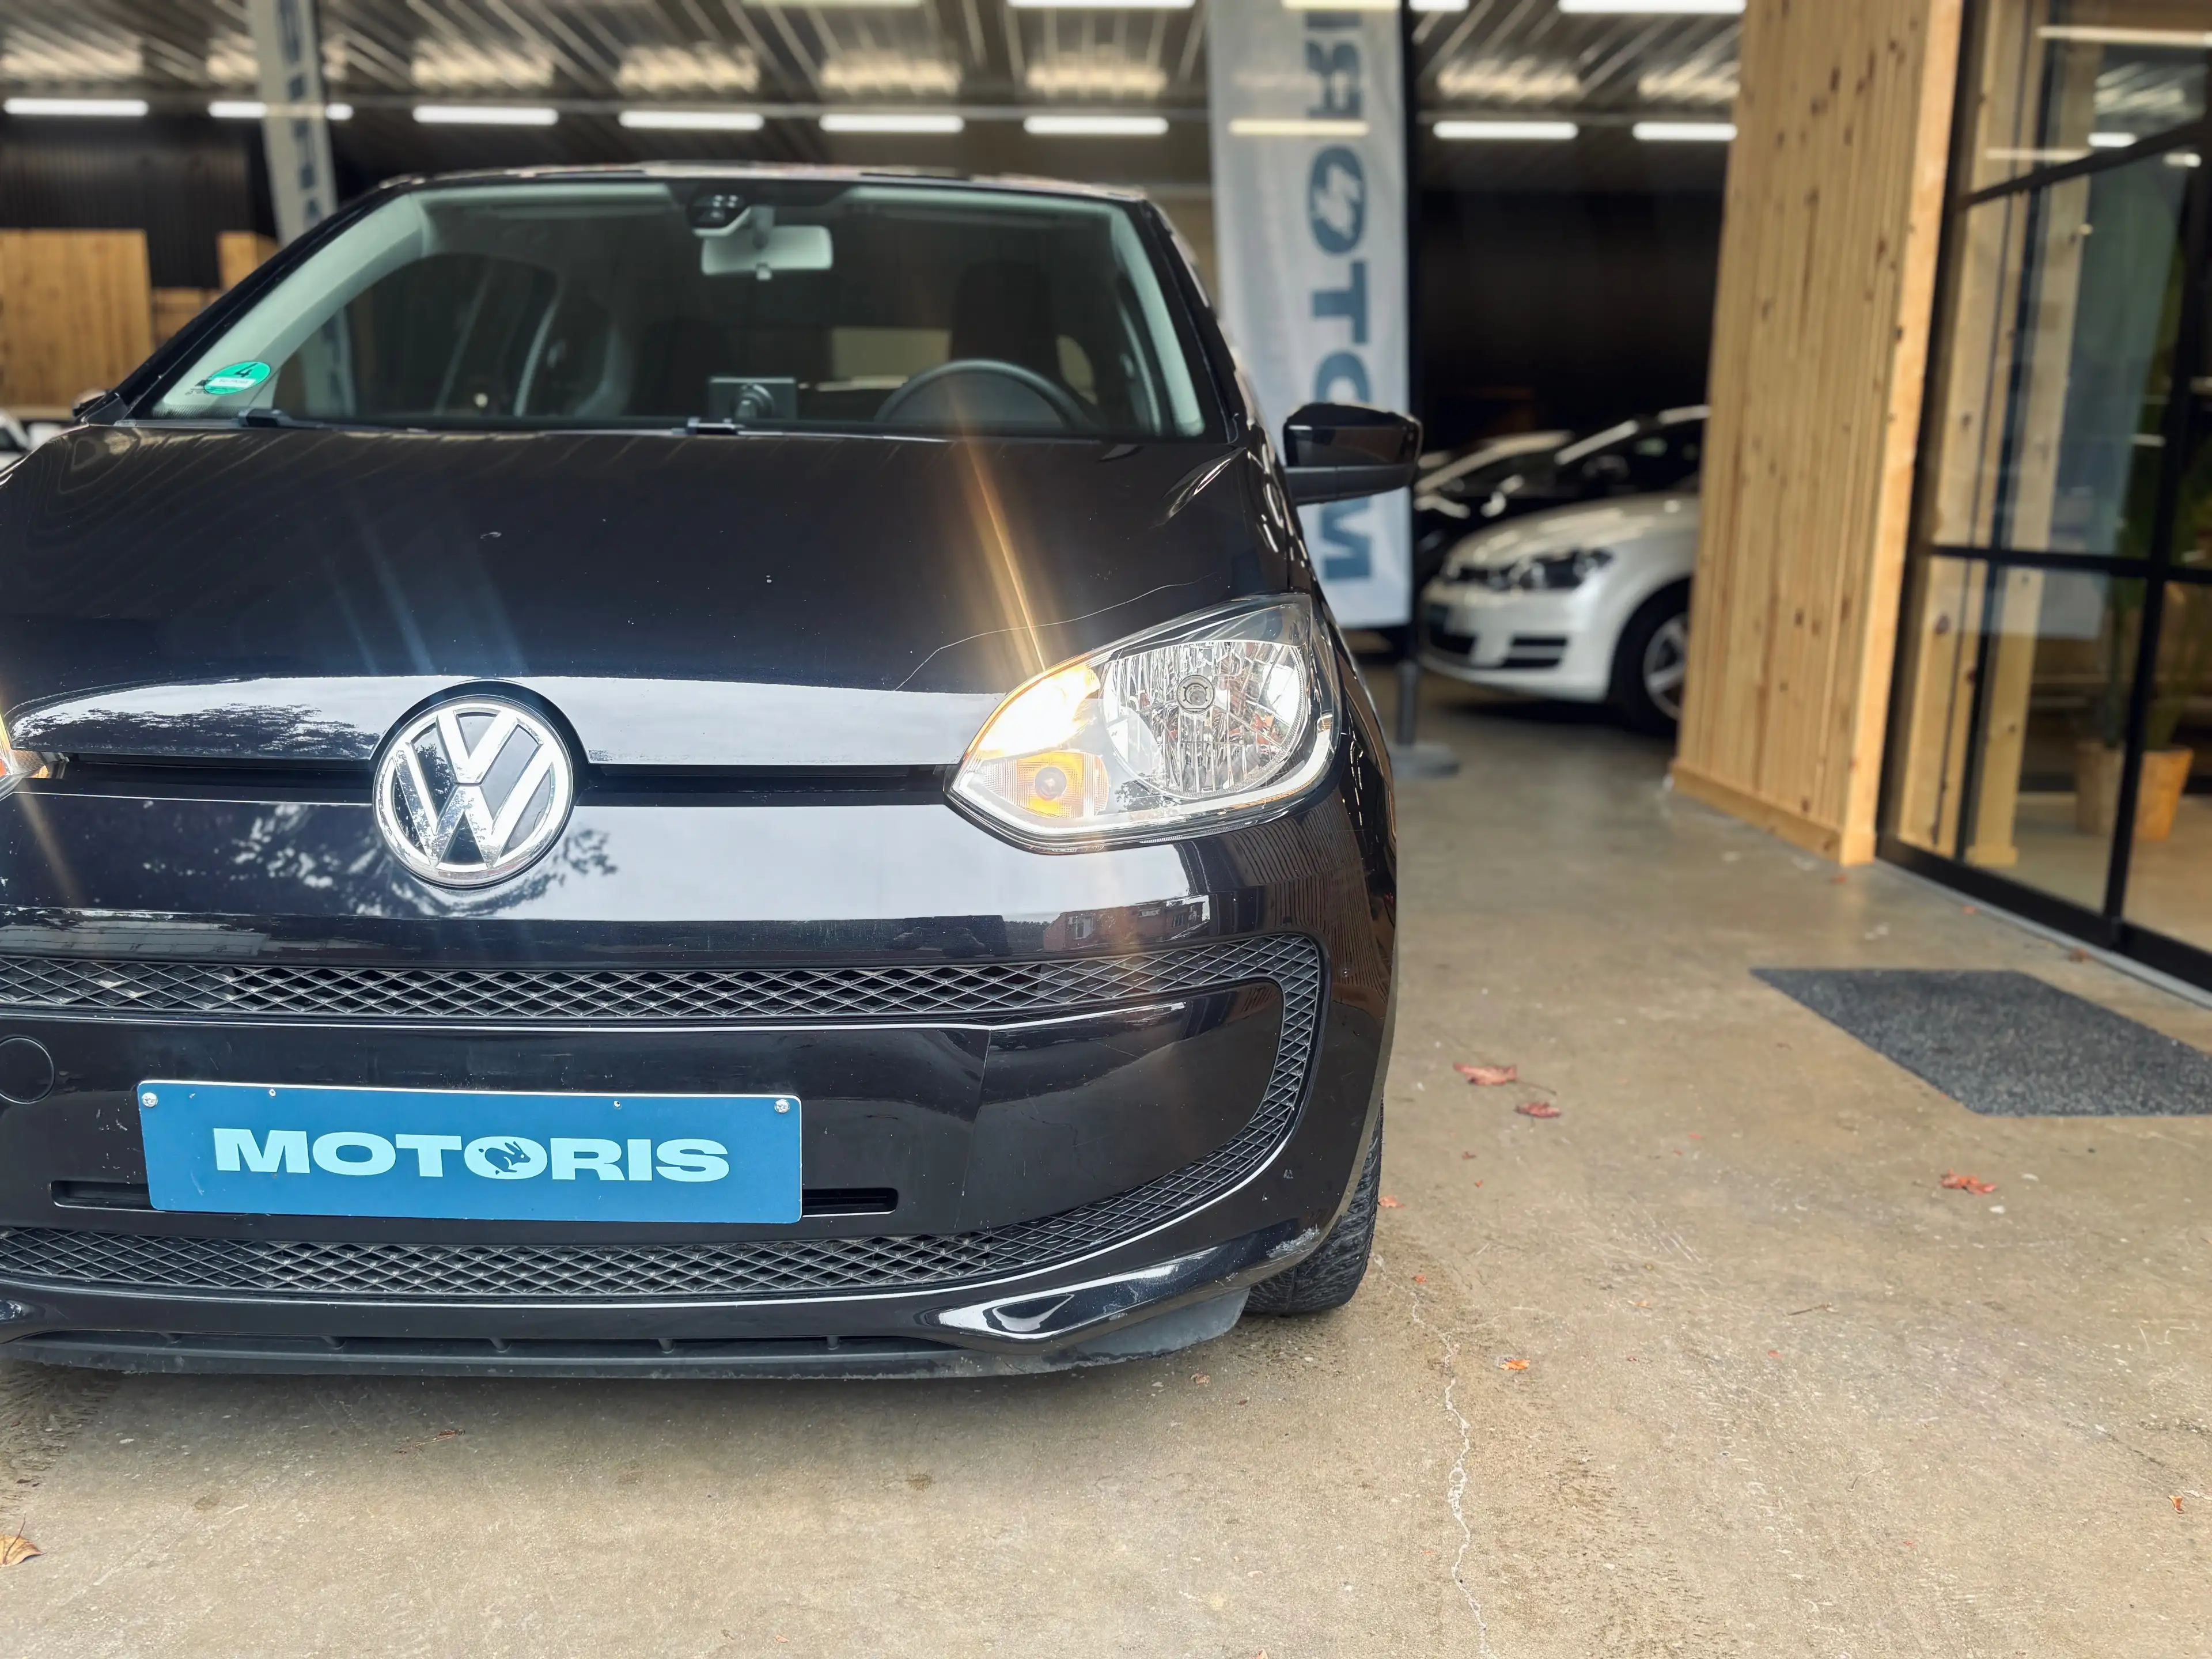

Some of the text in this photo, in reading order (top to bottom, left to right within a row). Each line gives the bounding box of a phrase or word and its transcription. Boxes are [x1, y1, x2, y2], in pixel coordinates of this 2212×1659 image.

[234, 363, 259, 378] 4
[387, 703, 561, 870] VW
[213, 1127, 730, 1182] MOTORIS
